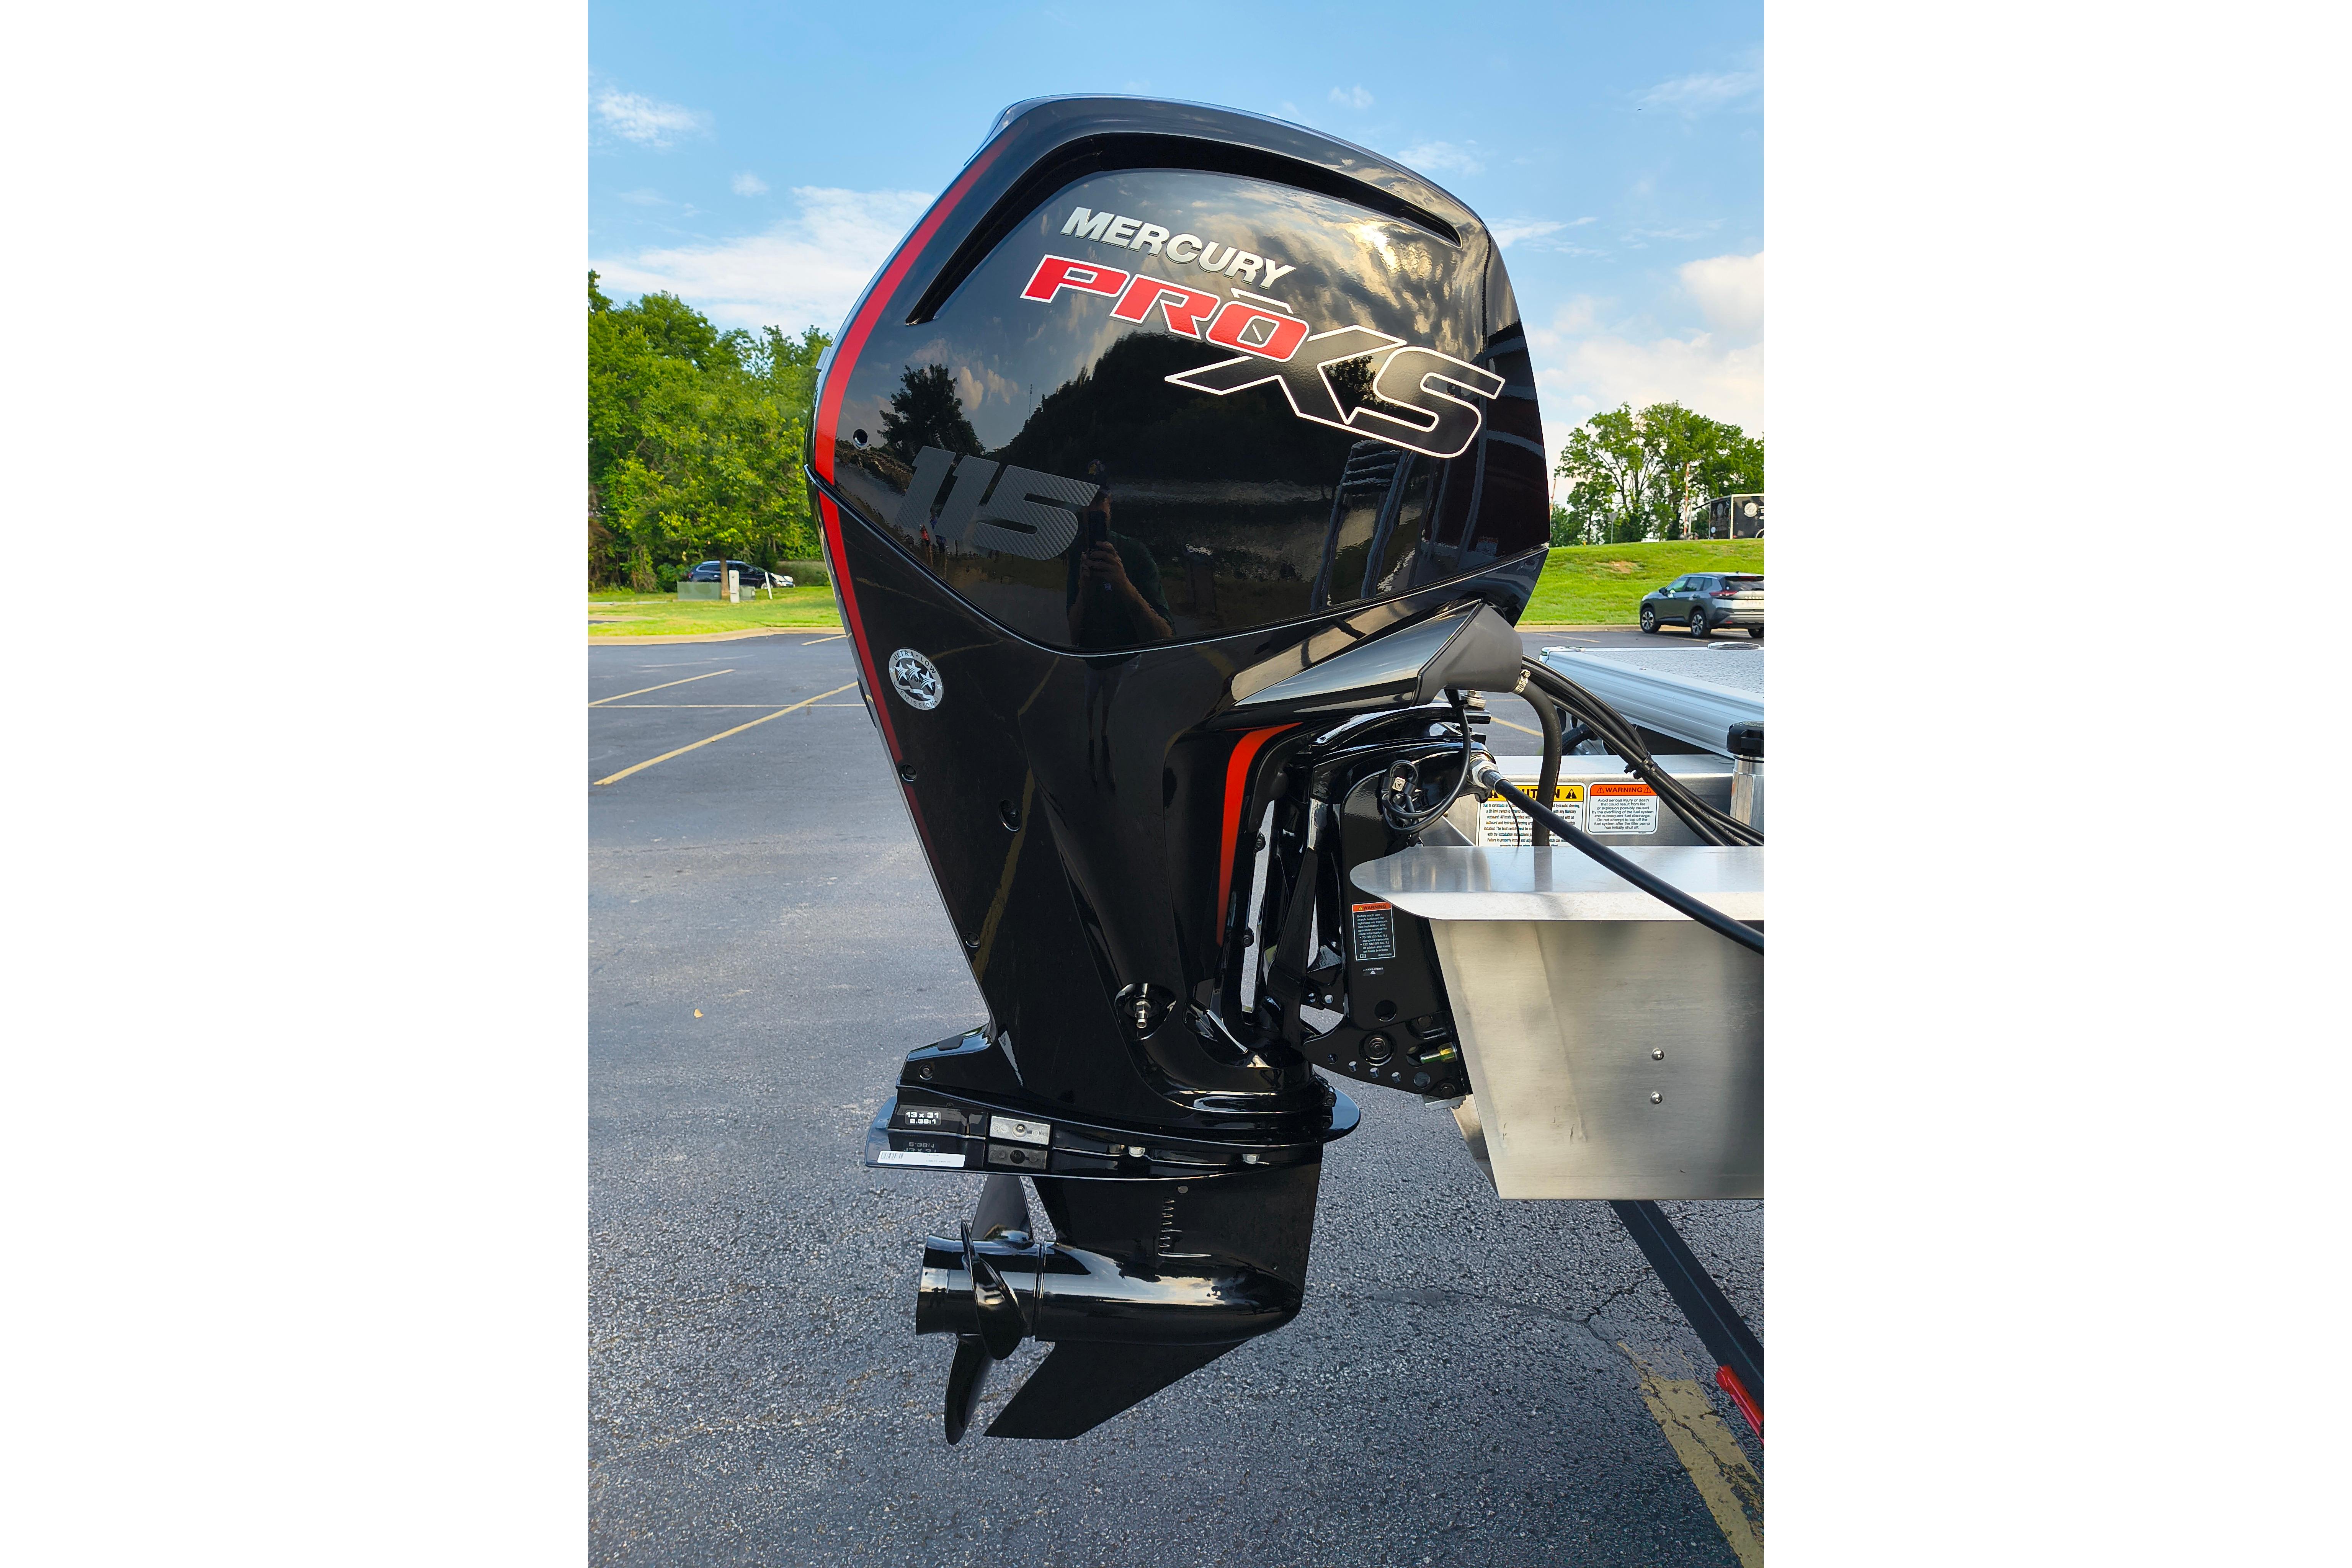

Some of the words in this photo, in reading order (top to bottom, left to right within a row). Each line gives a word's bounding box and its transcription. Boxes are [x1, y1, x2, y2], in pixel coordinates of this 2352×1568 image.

[1060, 206, 1297, 290] MERCURY
[1020, 254, 1309, 363] PRO
[1165, 325, 1506, 458] XS
[895, 446, 1100, 560] 115
[893, 650, 914, 660] ULTRA
[921, 657, 936, 673] LOW
[900, 691, 935, 708] EMISSION
